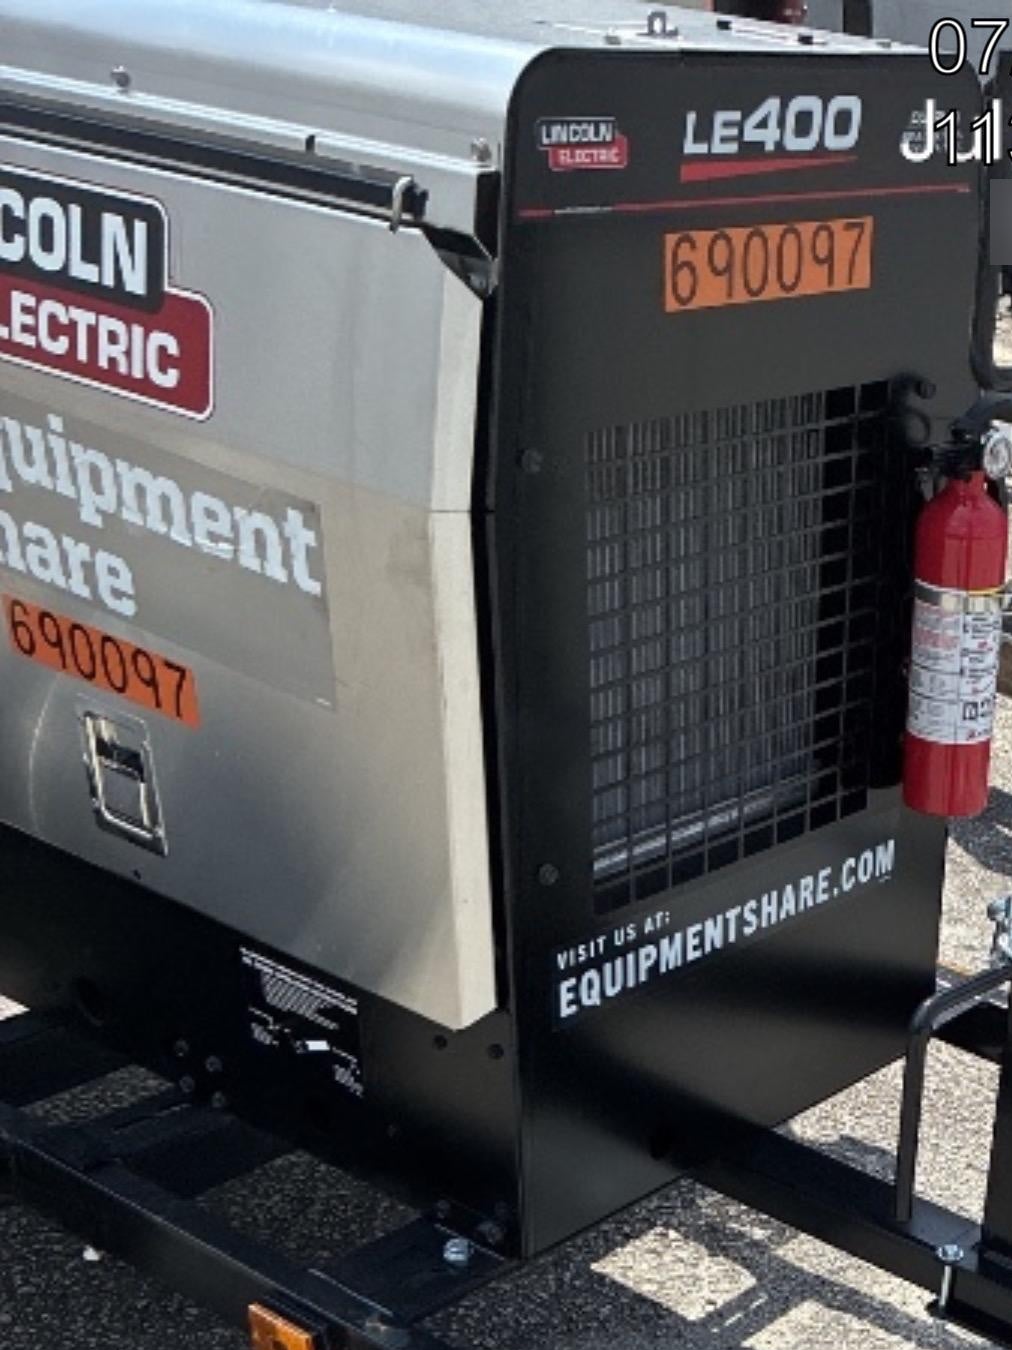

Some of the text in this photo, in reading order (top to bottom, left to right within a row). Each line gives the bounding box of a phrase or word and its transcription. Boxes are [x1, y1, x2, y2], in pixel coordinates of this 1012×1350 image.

[541, 121, 613, 146] LINCOLN
[682, 95, 863, 155] LE400
[670, 222, 866, 308] 690097
[9, 599, 187, 719] 690097
[556, 909, 672, 971] VISIT US AT:
[559, 838, 896, 1019] EQUIPMENTSHARE.COM
